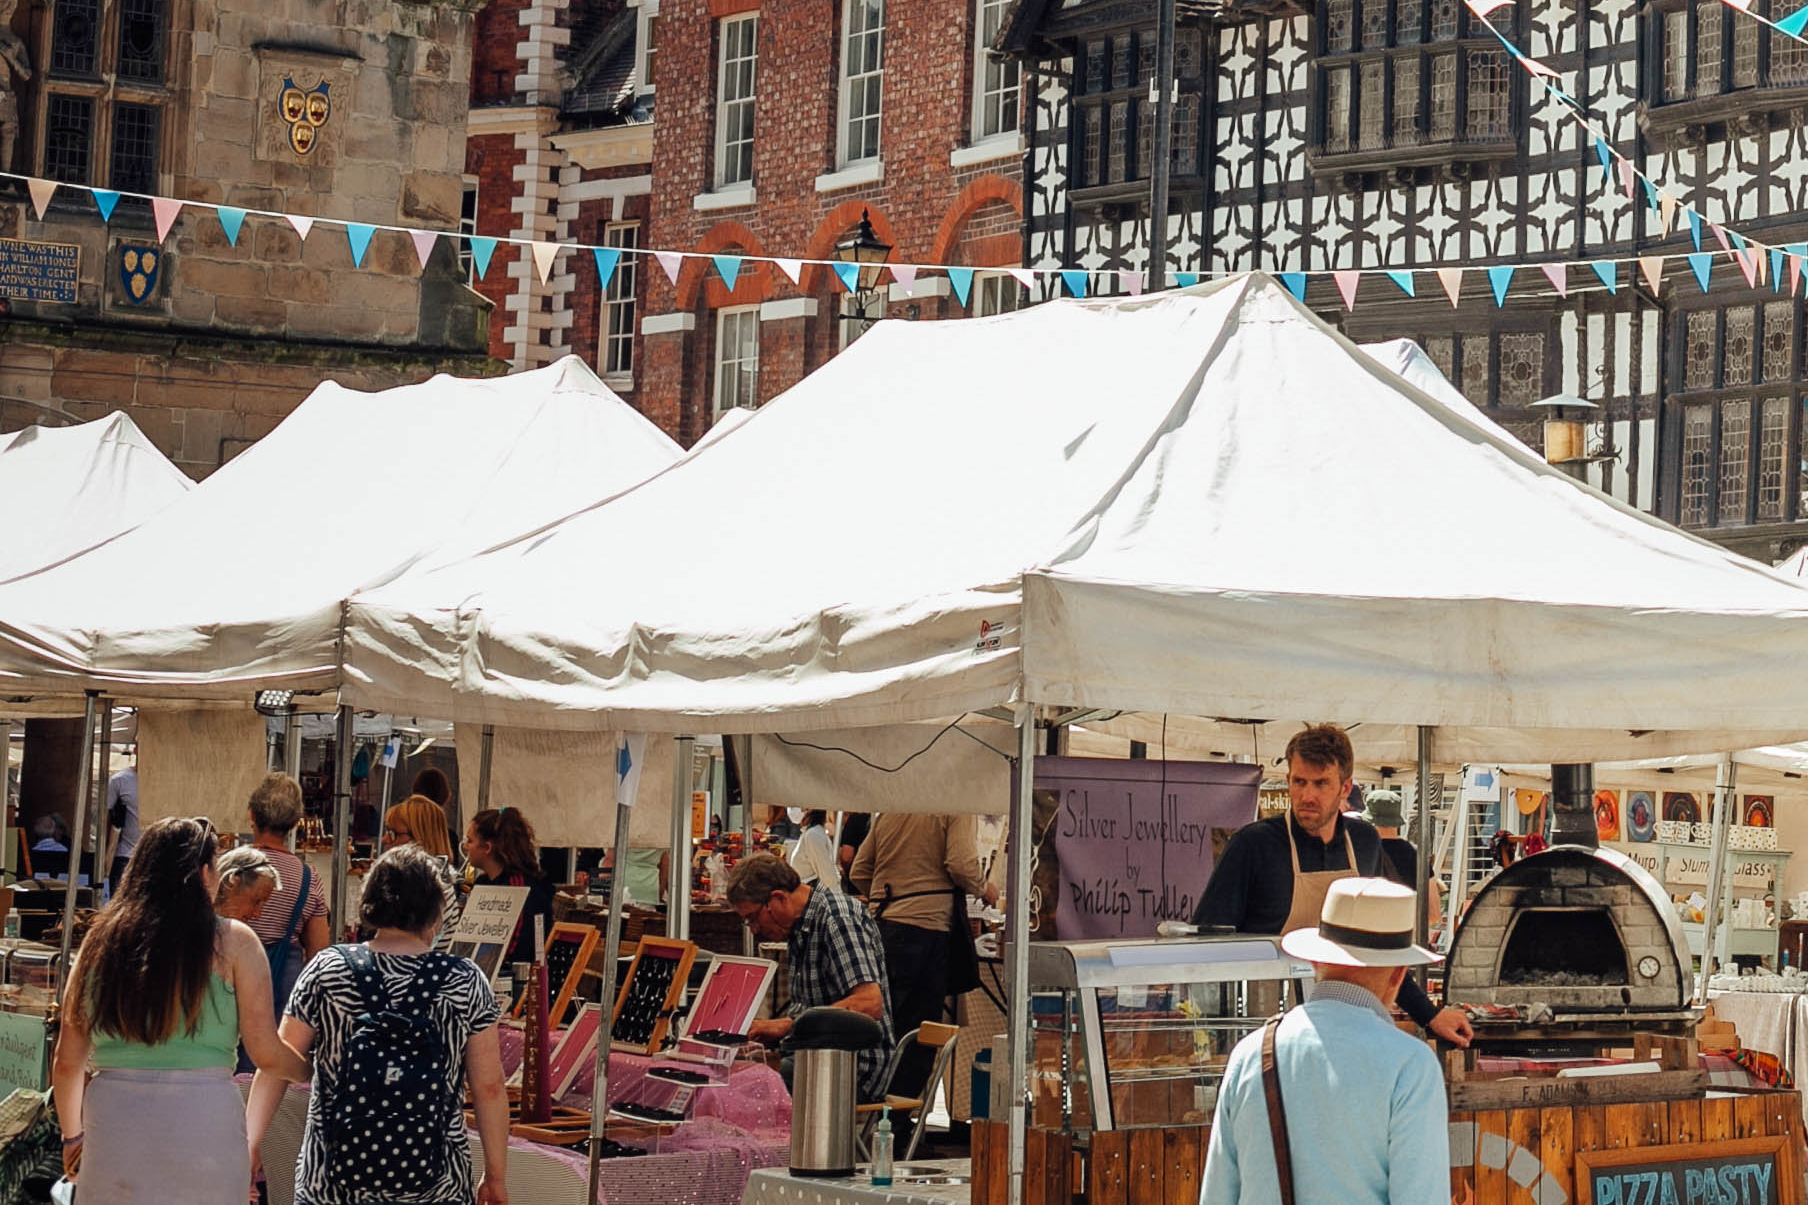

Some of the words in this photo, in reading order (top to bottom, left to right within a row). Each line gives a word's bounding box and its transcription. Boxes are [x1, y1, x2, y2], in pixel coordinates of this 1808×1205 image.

[11, 253, 47, 265] WILLIAM
[48, 246, 75, 257] THIS
[47, 268, 75, 278] GENT
[1063, 789, 1116, 839] Silver
[1122, 791, 1207, 858] Jewellery
[1126, 846, 1141, 887] by
[1069, 879, 1131, 933] Philip
[1596, 1171, 1679, 1205] PIZZA
[1686, 1163, 1772, 1205] PASTY
